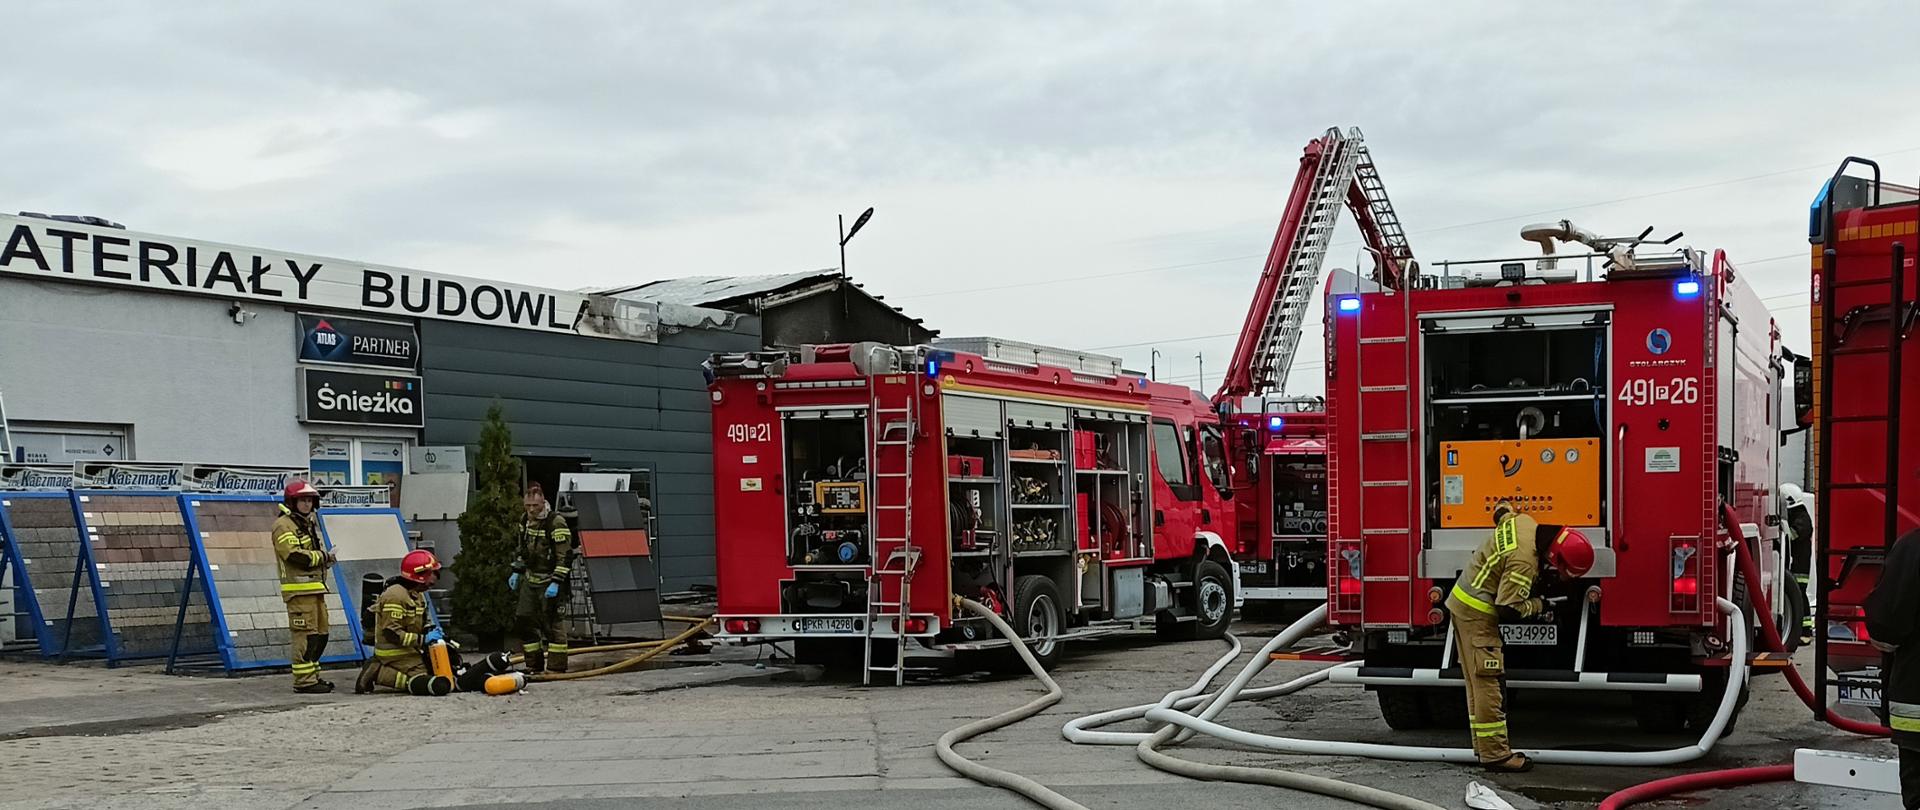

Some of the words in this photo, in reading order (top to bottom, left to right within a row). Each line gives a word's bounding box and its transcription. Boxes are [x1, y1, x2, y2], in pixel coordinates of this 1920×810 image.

[0, 224, 323, 300] ATERIAŁY
[316, 332, 336, 346] ATLAS
[352, 336, 410, 356] PARTNER
[1629, 359, 1687, 368] STOLARCZYK
[317, 382, 413, 414] Śnieżka
[807, 619, 824, 630] PKR
[826, 619, 851, 630] 14298
[1515, 625, 1556, 641] 34998
